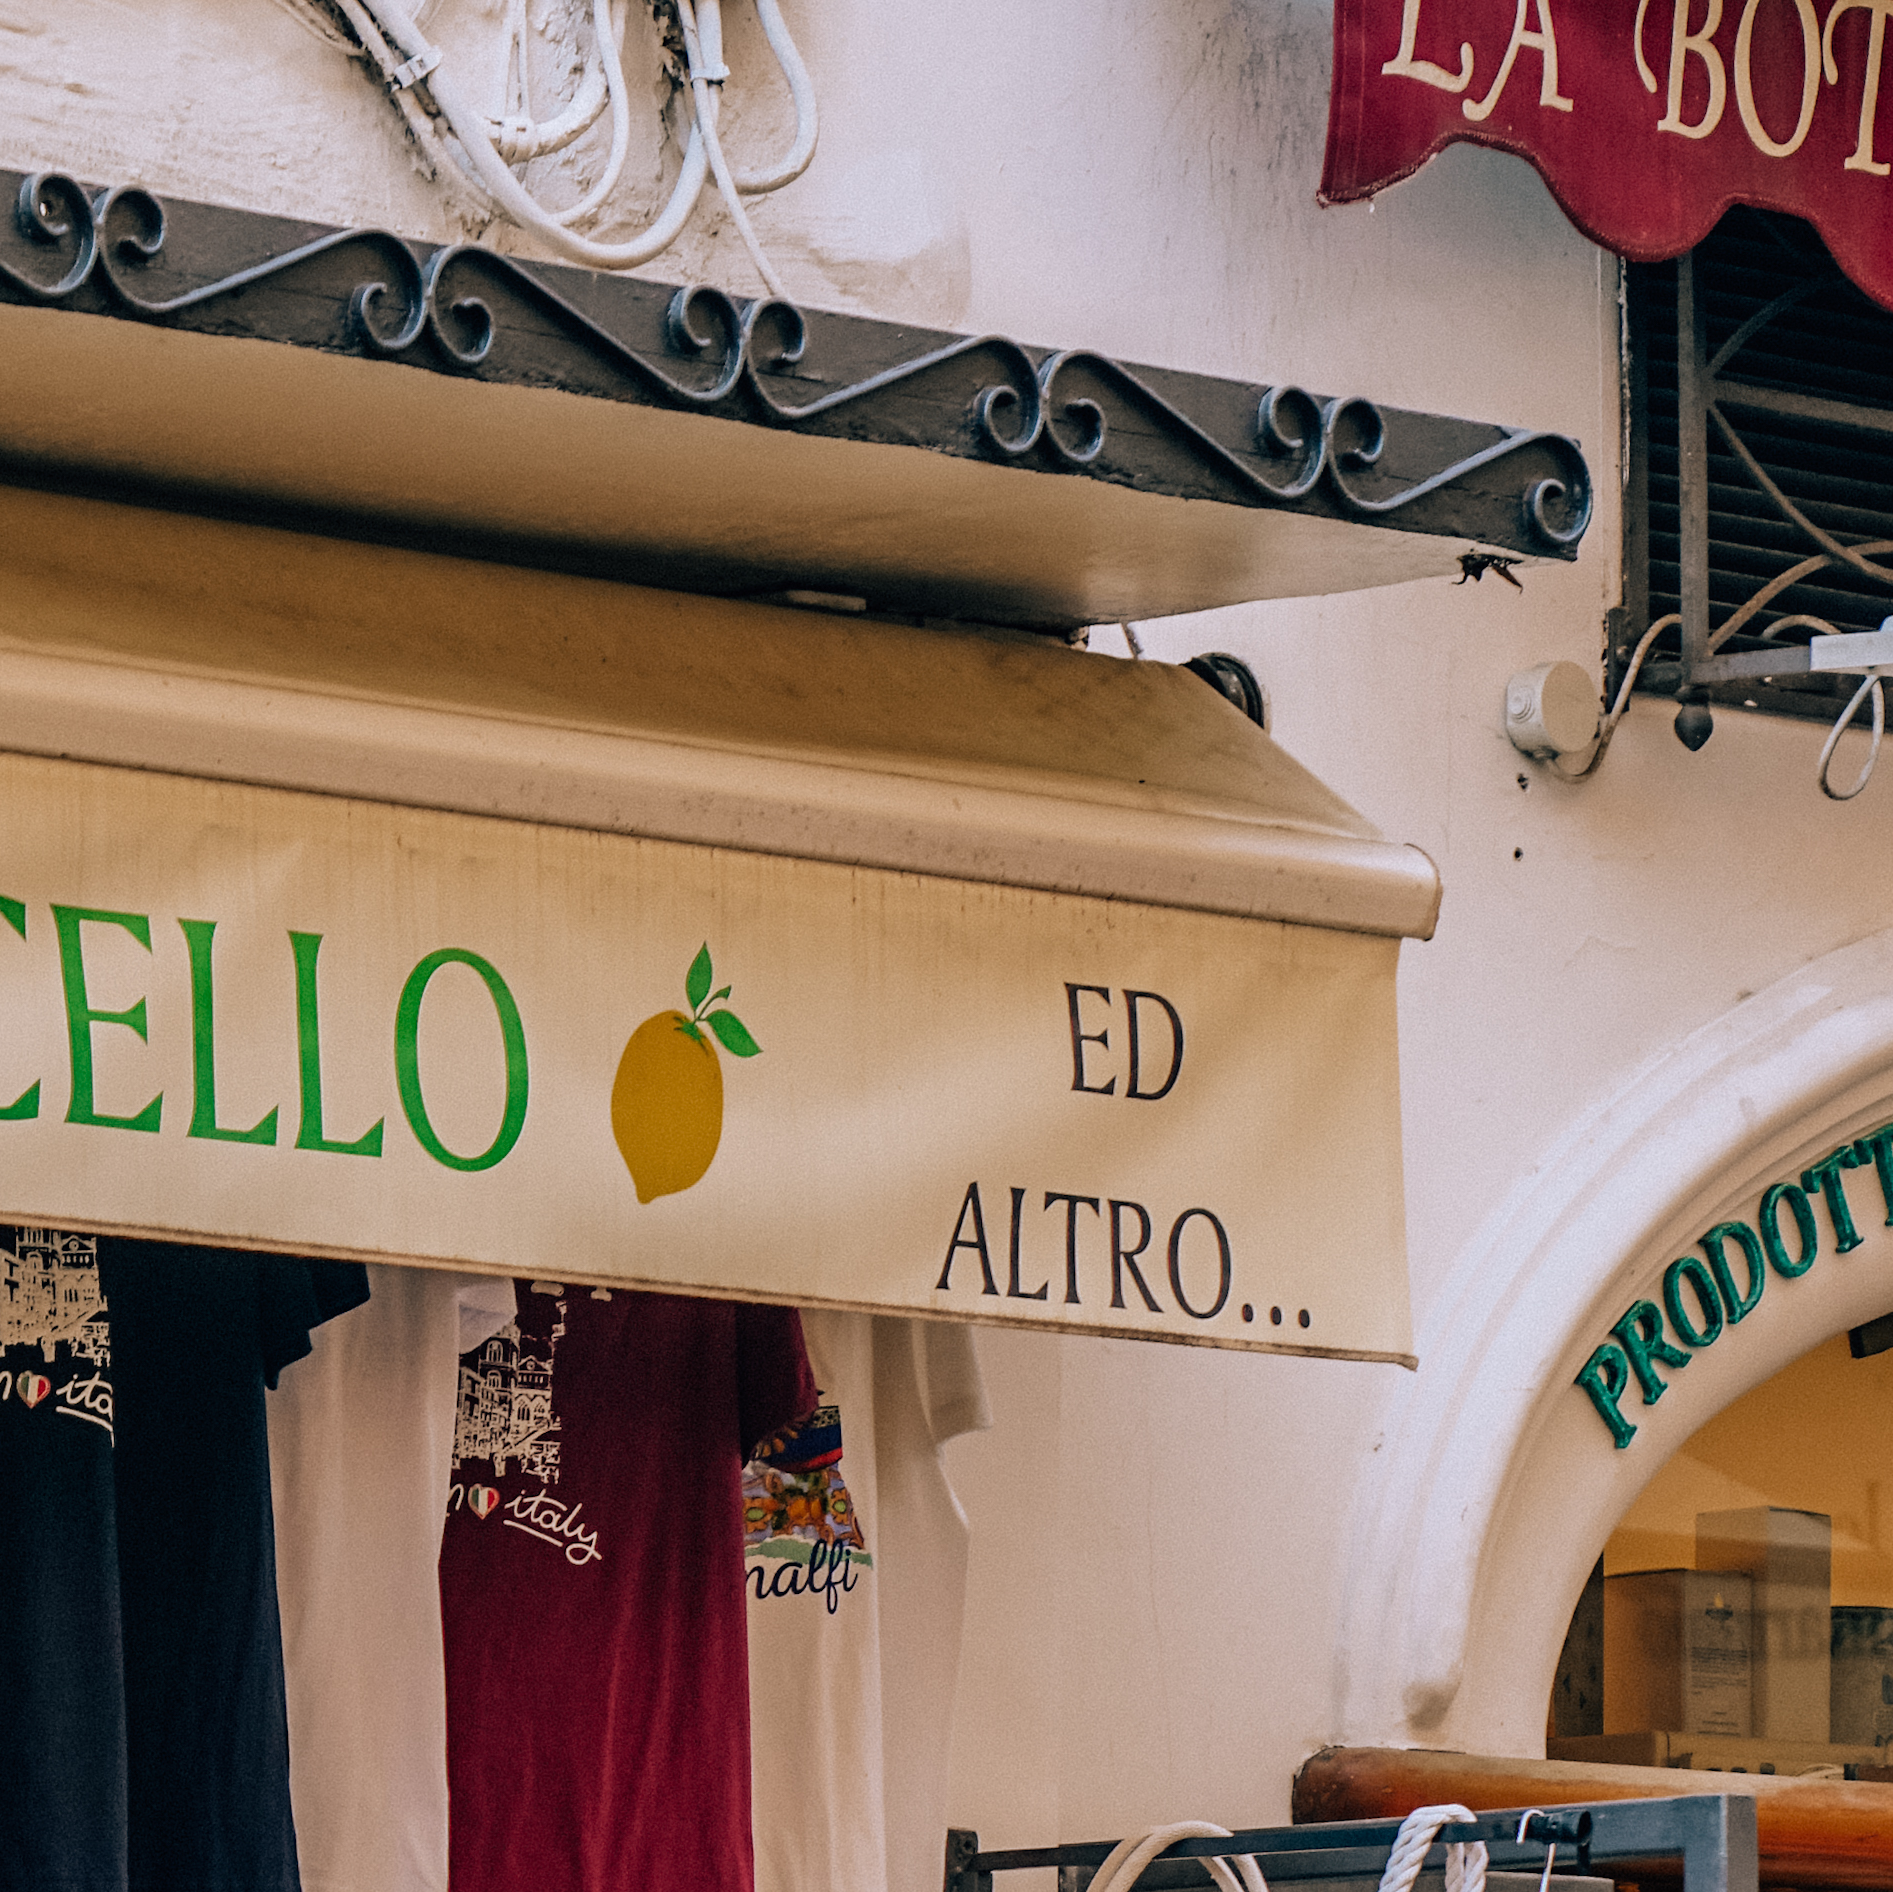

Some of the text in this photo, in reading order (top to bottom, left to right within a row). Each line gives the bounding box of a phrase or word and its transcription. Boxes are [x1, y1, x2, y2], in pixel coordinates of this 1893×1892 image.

[1064, 982, 1184, 1100] ED
[935, 1181, 1311, 1329] ALTRO...
[505, 1489, 602, 1566] italy
